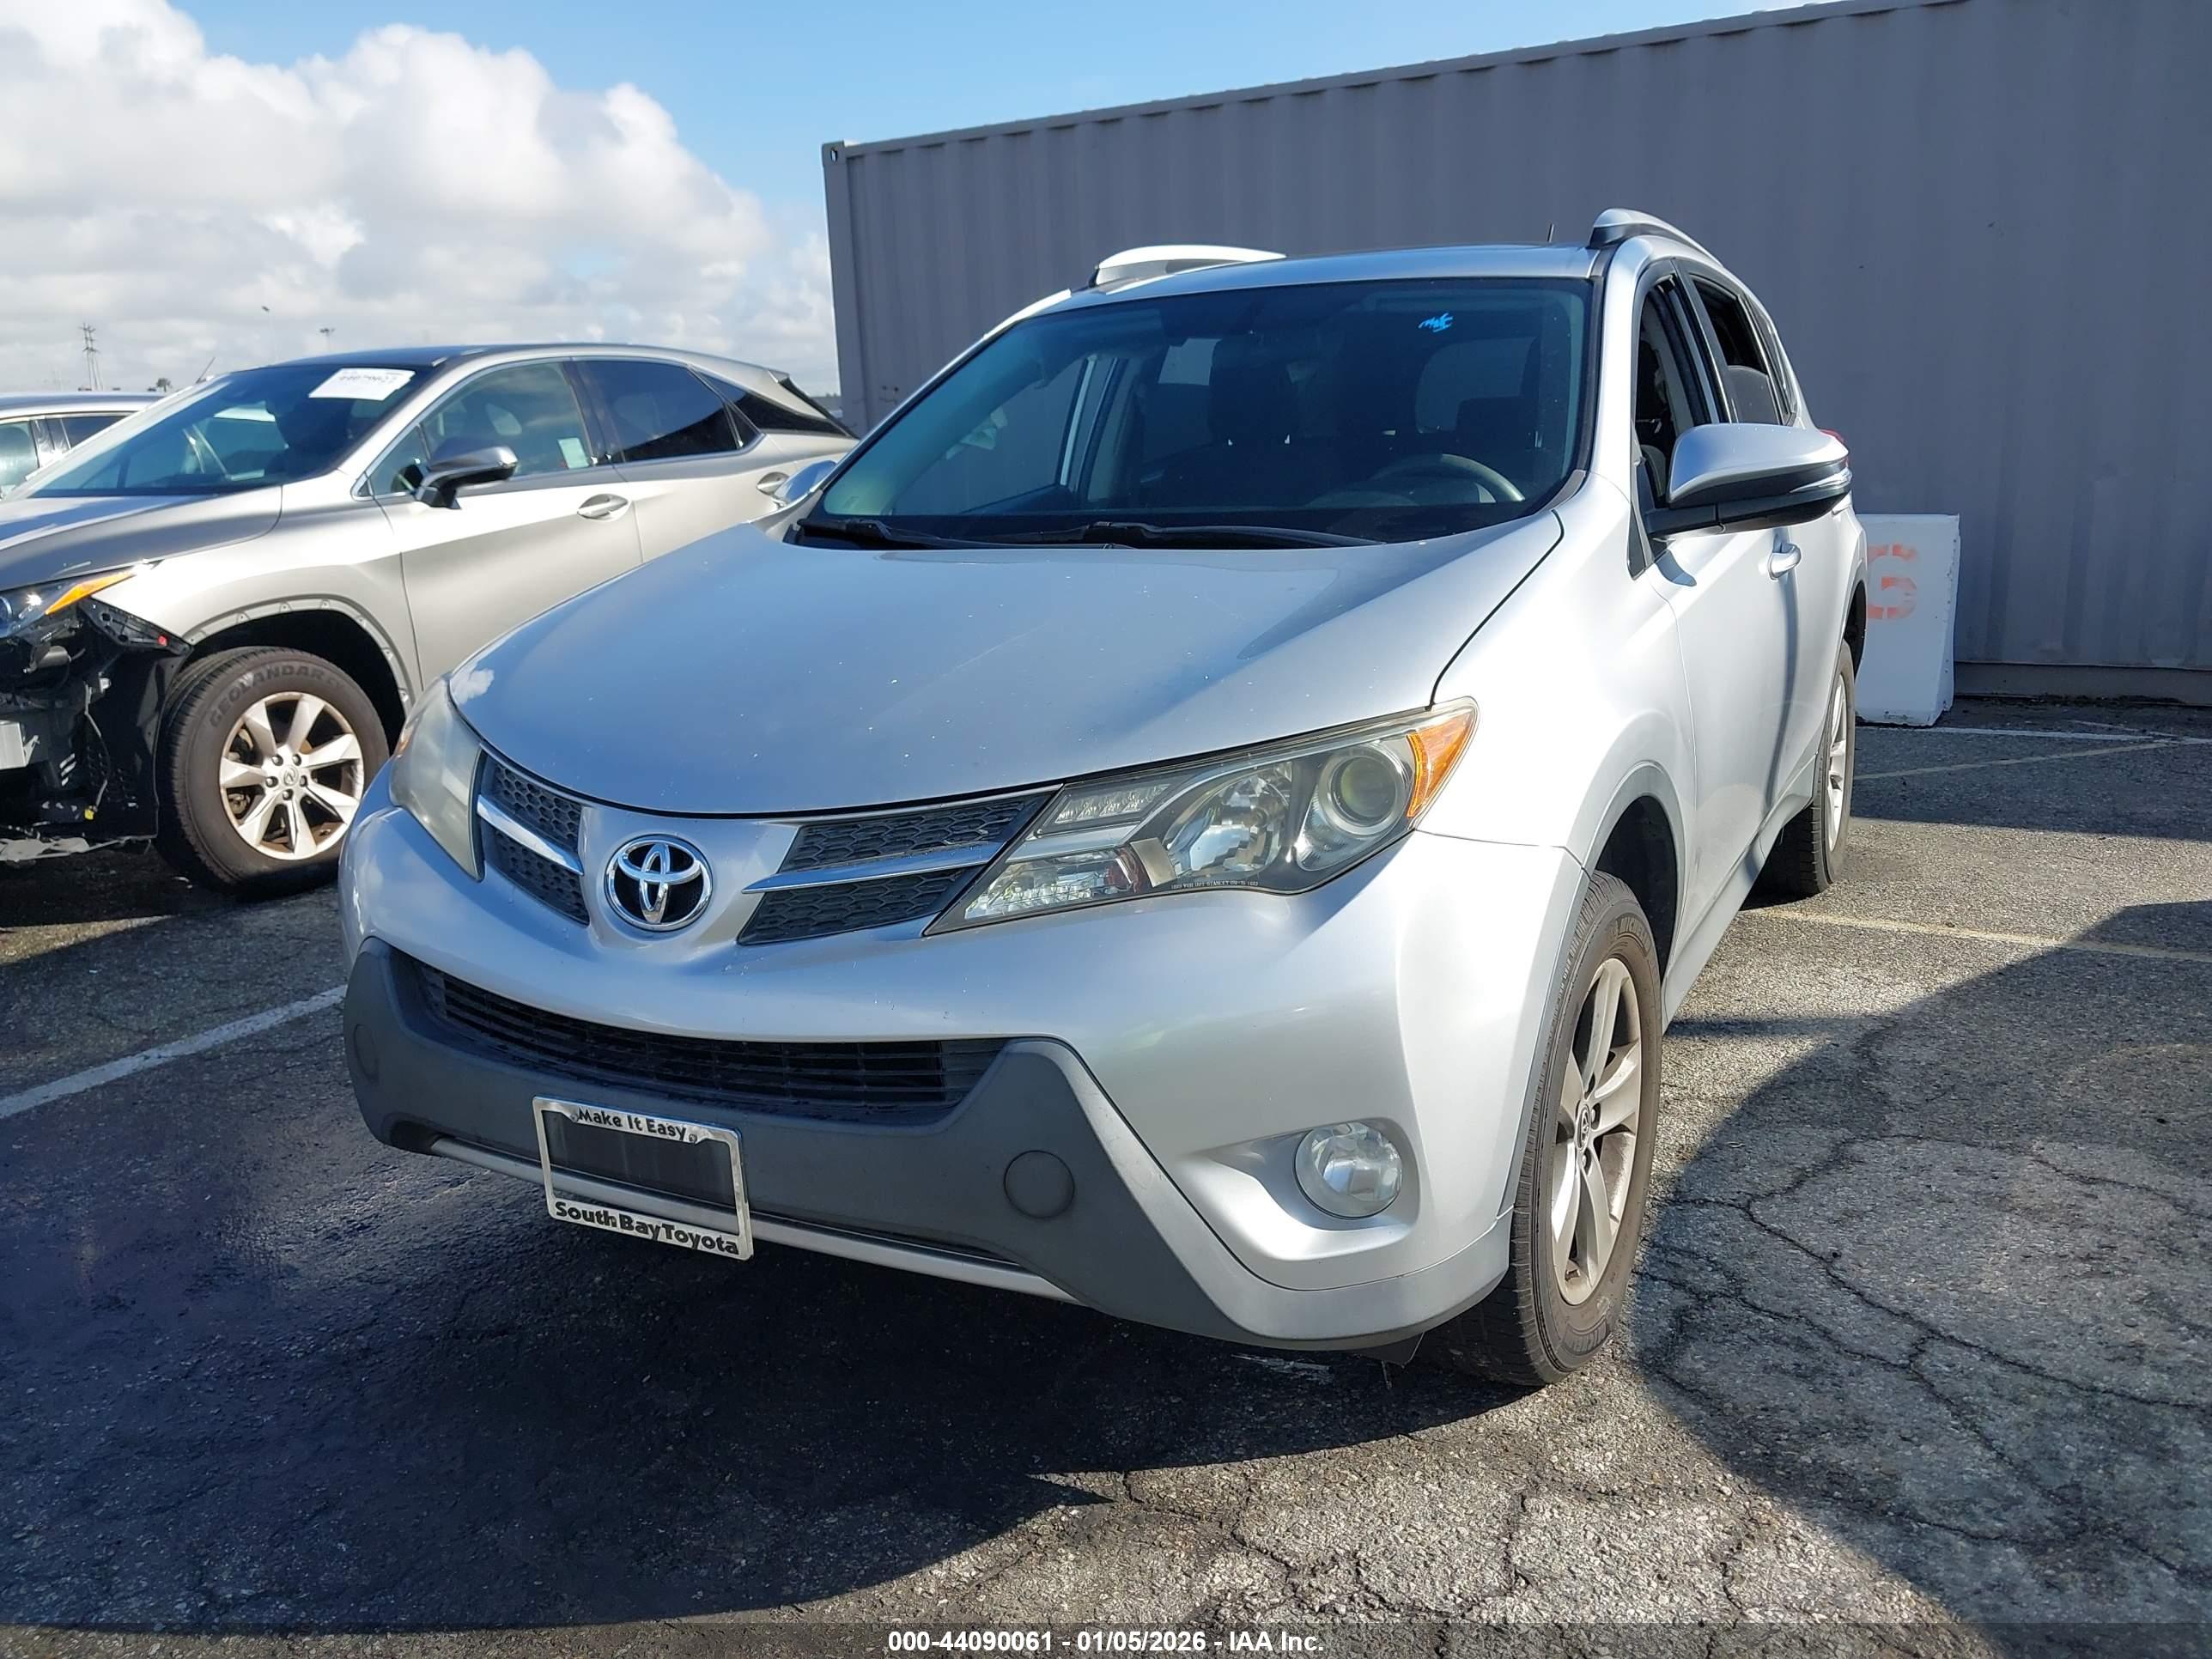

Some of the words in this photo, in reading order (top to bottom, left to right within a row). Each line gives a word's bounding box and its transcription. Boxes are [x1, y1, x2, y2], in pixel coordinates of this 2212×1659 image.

[210, 665, 325, 727] GEOLANDAR
[578, 1108, 623, 1127] Make
[628, 1115, 643, 1132] It
[646, 1119, 687, 1141] Easy
